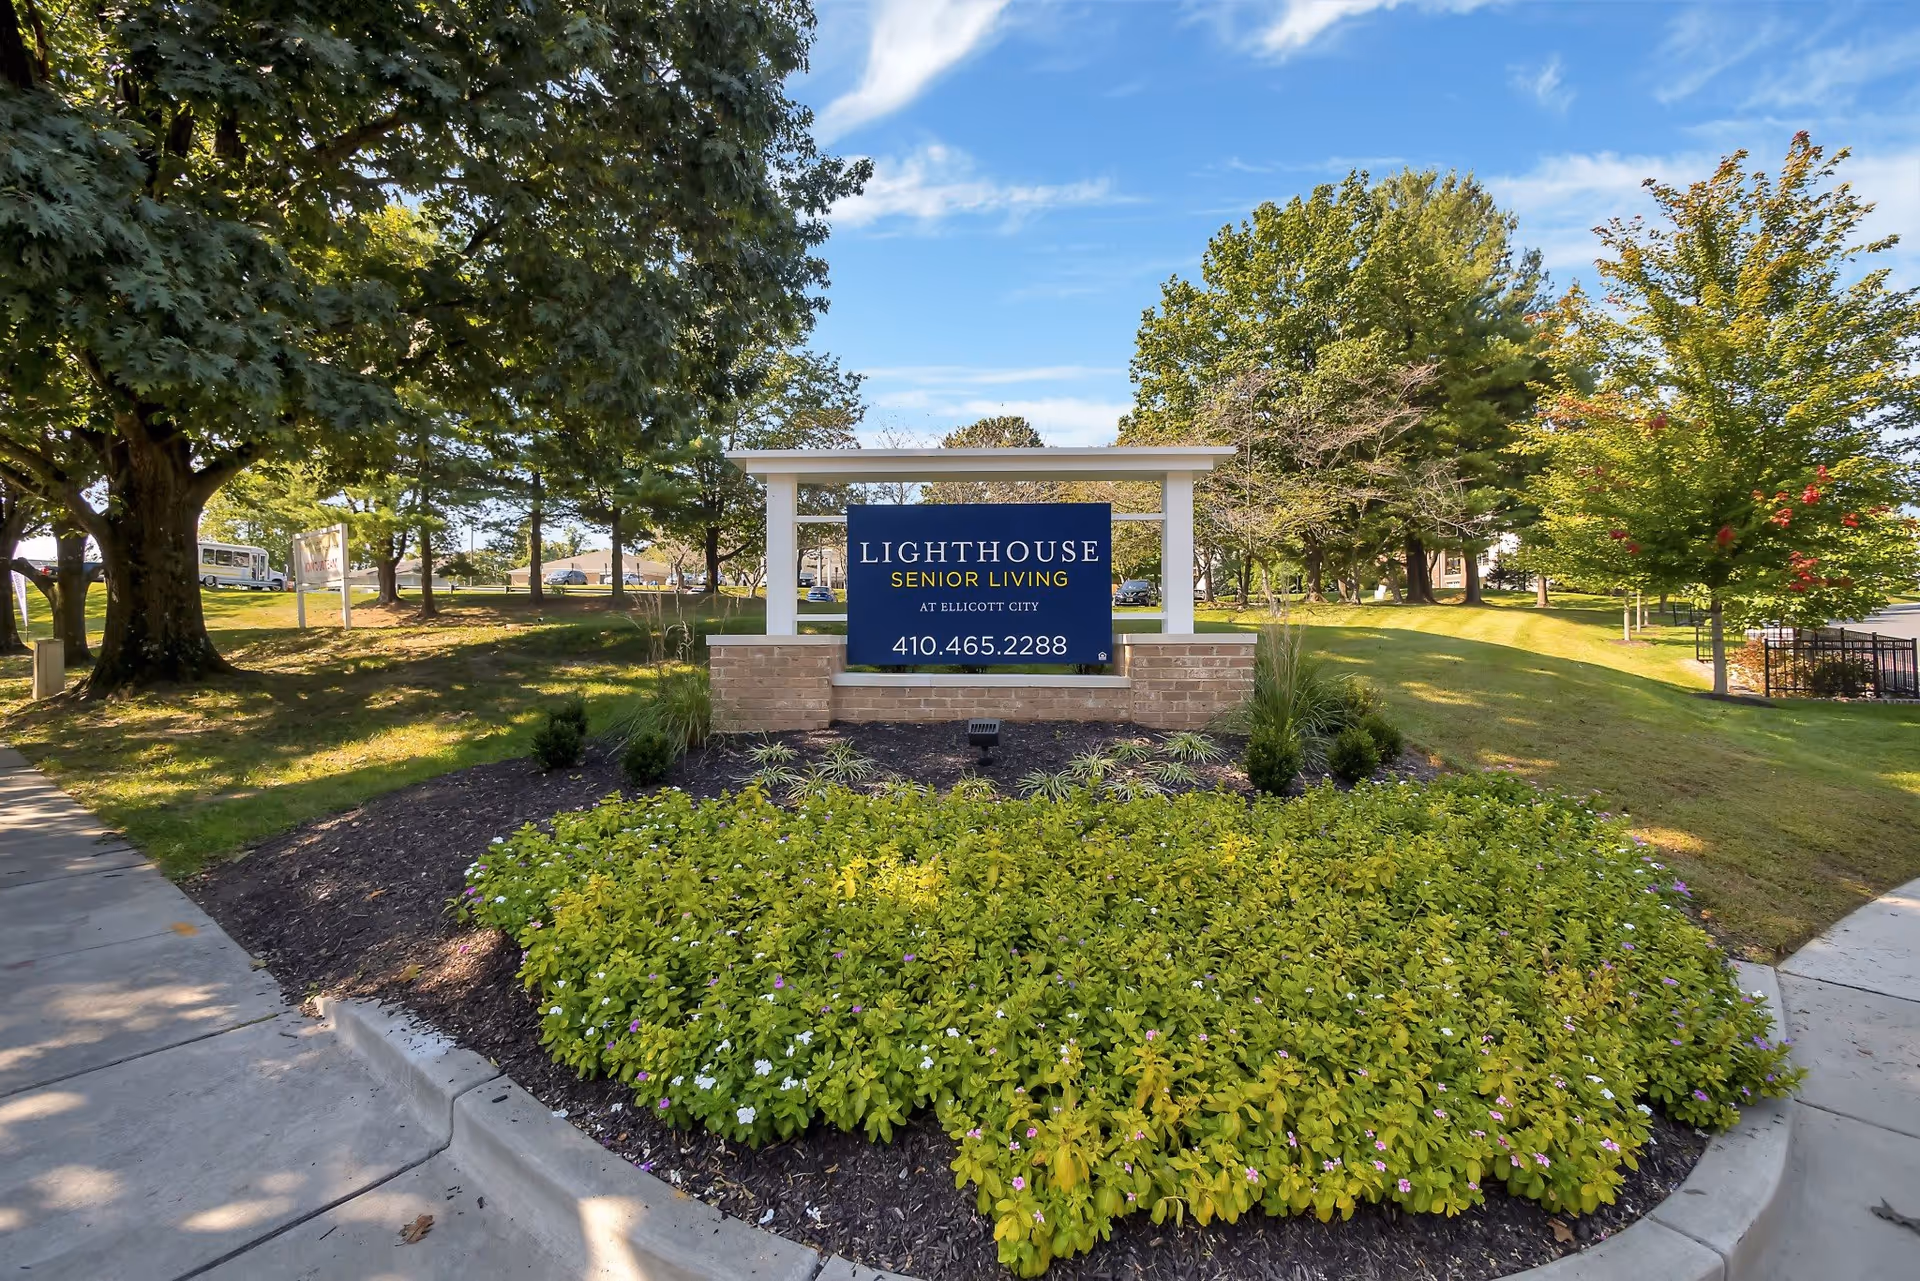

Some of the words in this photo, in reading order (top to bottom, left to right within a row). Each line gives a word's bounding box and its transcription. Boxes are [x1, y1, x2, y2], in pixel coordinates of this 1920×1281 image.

[859, 540, 1100, 564] LIGHTHOUSE
[891, 571, 979, 588] SENIOR
[989, 570, 1069, 588] LIVING
[919, 602, 937, 612] AT
[940, 602, 1005, 612] ELLICOTT
[1008, 601, 1039, 612] CITY
[892, 635, 1068, 656] 410.465.2288
